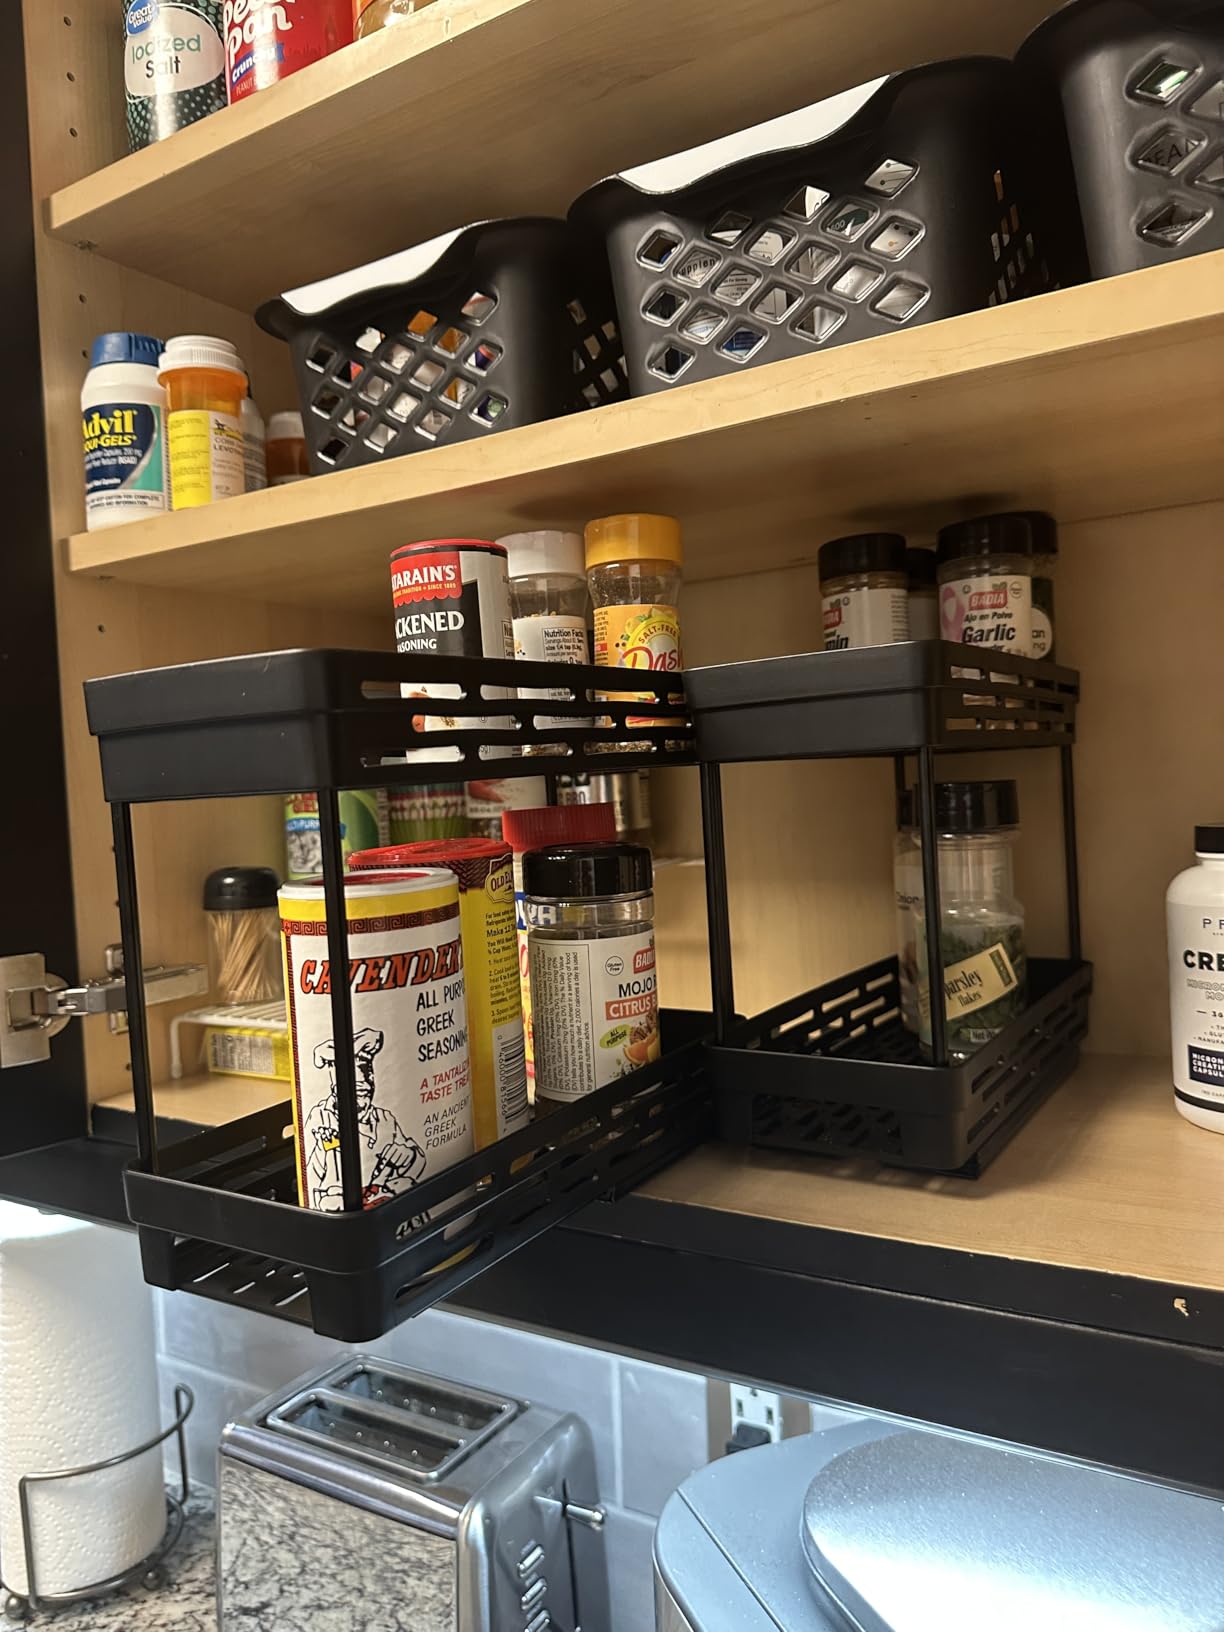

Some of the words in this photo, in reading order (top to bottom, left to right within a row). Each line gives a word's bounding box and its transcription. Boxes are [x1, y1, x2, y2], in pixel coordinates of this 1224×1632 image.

[128, 3, 153, 23] Great
[228, 4, 294, 70] Pan
[131, 34, 201, 65] Iodized
[145, 55, 181, 79] Salt
[970, 592, 1005, 608] BADIA
[992, 611, 1013, 620] Polvo
[544, 628, 571, 638] Nutrition
[638, 623, 677, 644] SALT-FREE
[962, 623, 1017, 643] Garlic
[300, 935, 464, 996] CAENDER
[618, 977, 653, 999] MOJO
[416, 989, 440, 1013] ALL
[609, 995, 651, 1018] CITRUS
[416, 1008, 455, 1037] GREEK
[1192, 1065, 1224, 1078] CAPSUL
[419, 1077, 429, 1090] A
[420, 1083, 453, 1104] TASTE
[424, 1111, 440, 1126] AN
[424, 1116, 457, 1138] GREEK
[426, 1123, 467, 1151] FORMULA
